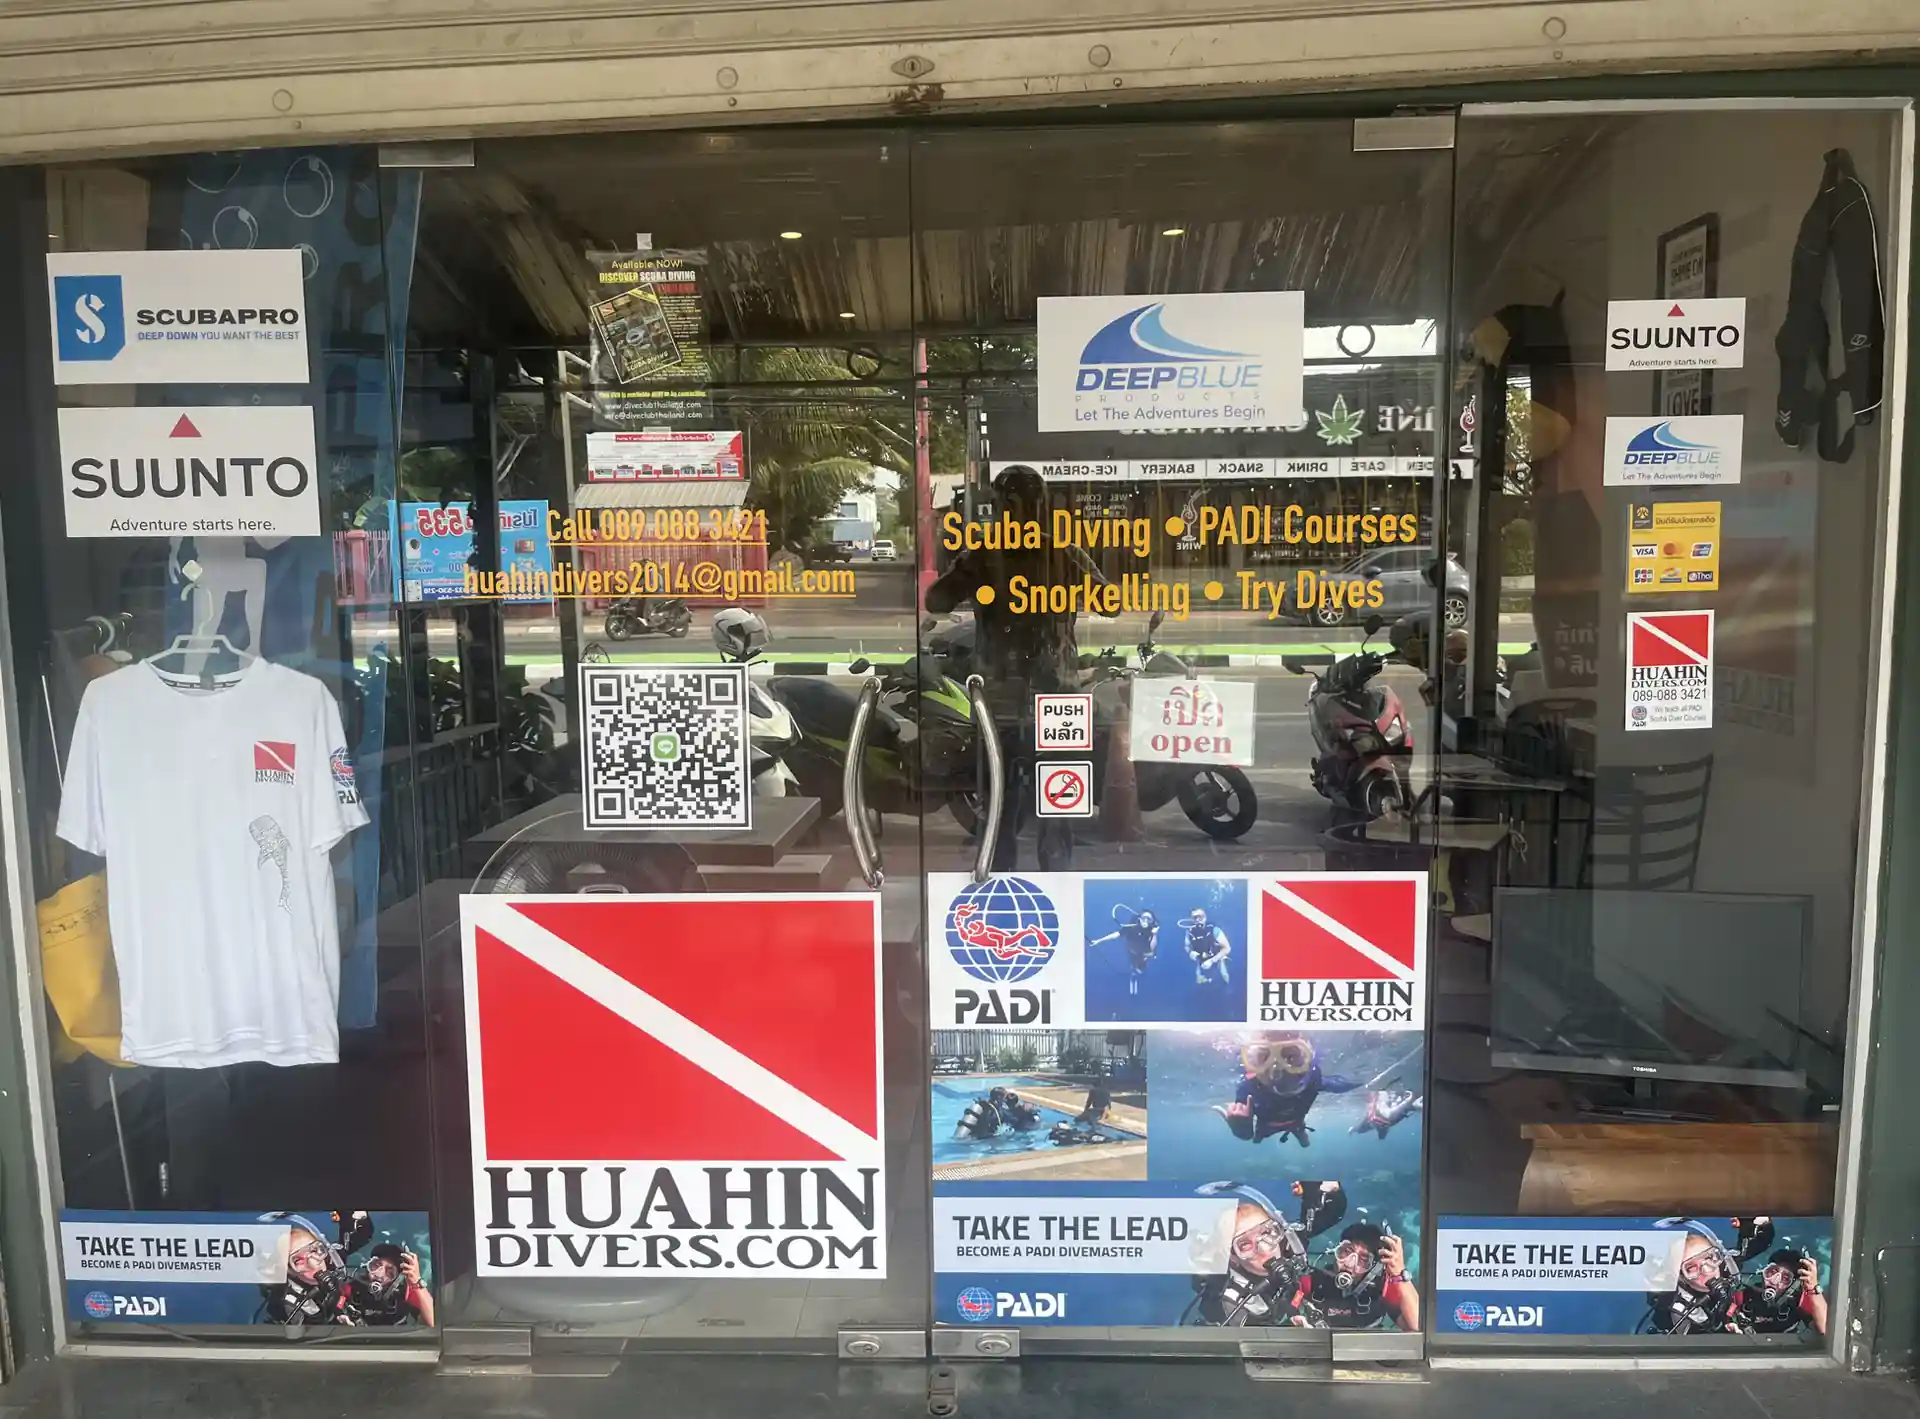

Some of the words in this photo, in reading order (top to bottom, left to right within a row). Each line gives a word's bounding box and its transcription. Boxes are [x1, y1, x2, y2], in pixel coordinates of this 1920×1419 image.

[612, 260, 654, 269] Available
[656, 259, 684, 269] NOW!
[600, 272, 638, 283] DISCOVER
[640, 271, 667, 282] SCUBA
[668, 270, 696, 281] DIVING
[136, 308, 299, 325] SCUBAPRO
[138, 331, 165, 341] DEEP
[166, 331, 198, 341] DOWN
[200, 331, 221, 341] YOU
[222, 330, 251, 341] WANT
[254, 330, 273, 340] THE
[275, 330, 300, 340] BEST
[1611, 326, 1739, 350] SUUNTO
[1629, 358, 1672, 367] Adventure
[1674, 358, 1696, 366] starts
[1075, 364, 1262, 392] DEEPBLUE
[1075, 408, 1096, 422] Let
[1102, 408, 1129, 421] The
[1134, 406, 1218, 420] Adventures
[1224, 405, 1266, 420] Begin
[1624, 452, 1721, 464] DEEPBLUE
[70, 456, 309, 498] SUUNTO
[1622, 472, 1635, 480] Let
[1638, 472, 1650, 480] The
[1654, 472, 1698, 480] Adventures
[1700, 472, 1722, 480] Begin
[110, 518, 188, 532] Adventure
[192, 518, 234, 531] starts
[238, 518, 276, 531] here.
[546, 509, 594, 541] Call
[600, 509, 644, 541] 089
[655, 509, 700, 541] 088
[709, 508, 767, 541] 3421
[943, 511, 1041, 549] Scuba
[1053, 508, 1151, 558] Diving
[1201, 503, 1271, 544] PADI
[1284, 504, 1417, 545] Courses
[464, 562, 856, 600] huahindivers2014@gmail.com
[1008, 572, 1192, 622] Snorkelling
[1237, 572, 1286, 621] Try
[1297, 570, 1384, 610] Dives
[1632, 665, 1708, 680] HUAHIN
[1632, 679, 1707, 688] DIVERS.COM
[1633, 689, 1677, 702] 089-088
[1681, 688, 1706, 700] 3421
[1044, 705, 1084, 716] PUSH
[1163, 685, 1224, 728] เปิด
[1044, 722, 1084, 741] ผลัก
[1151, 734, 1232, 758] open
[256, 770, 294, 780] HUAHIN
[1260, 980, 1414, 1007] HUAHIN
[955, 990, 1051, 1024] PADI
[1260, 1006, 1412, 1022] DIVERS.COM
[484, 1166, 880, 1231] HUAHIN
[952, 1215, 1030, 1240] TAKE
[1038, 1216, 1100, 1241] THE
[1110, 1216, 1188, 1241] LEAD
[76, 1236, 134, 1257] TAKE
[140, 1236, 187, 1258] THE
[194, 1237, 255, 1258] LEAD
[486, 1234, 878, 1270] DIVERS.COM
[957, 1246, 1010, 1258] BECOME
[1012, 1246, 1022, 1258] A
[1026, 1246, 1056, 1258] PADI
[1059, 1246, 1143, 1258] DIVEMASTER
[1453, 1244, 1516, 1264] TAKE
[1524, 1244, 1573, 1265] THE
[1582, 1244, 1646, 1266] LEAD
[81, 1260, 121, 1270] BECOME
[123, 1260, 130, 1270] A
[132, 1261, 156, 1270] PADI
[158, 1262, 222, 1271] DIVEMASTER
[1454, 1268, 1499, 1278] BECOME
[1501, 1269, 1509, 1278] A
[1512, 1269, 1537, 1278] PADI
[1540, 1269, 1608, 1278] DIVEMASTER
[113, 1295, 166, 1317] PADI
[996, 1292, 1066, 1318] PADI
[1486, 1305, 1543, 1327] PADI
